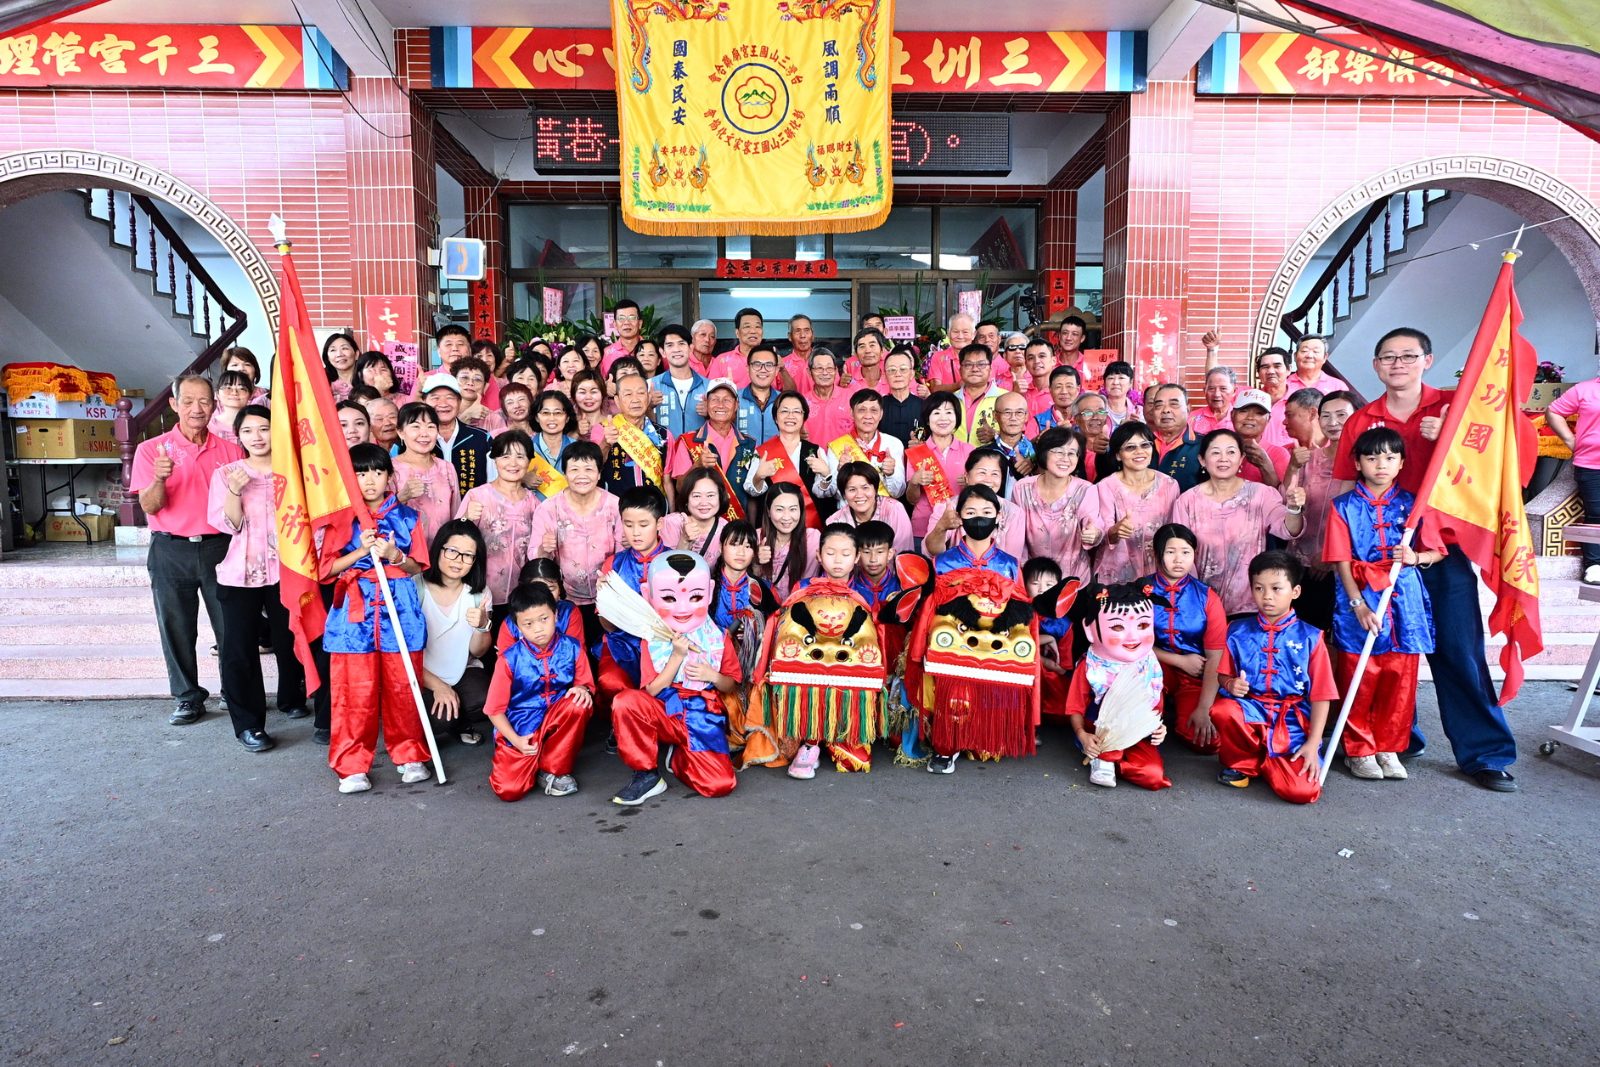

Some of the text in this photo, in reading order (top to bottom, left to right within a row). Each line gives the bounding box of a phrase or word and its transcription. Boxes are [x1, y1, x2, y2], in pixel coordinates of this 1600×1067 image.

[533, 43, 614, 78] 心
[671, 39, 688, 126] 國泰民安
[822, 39, 842, 125] 風調雨順
[86, 407, 107, 419] KSR
